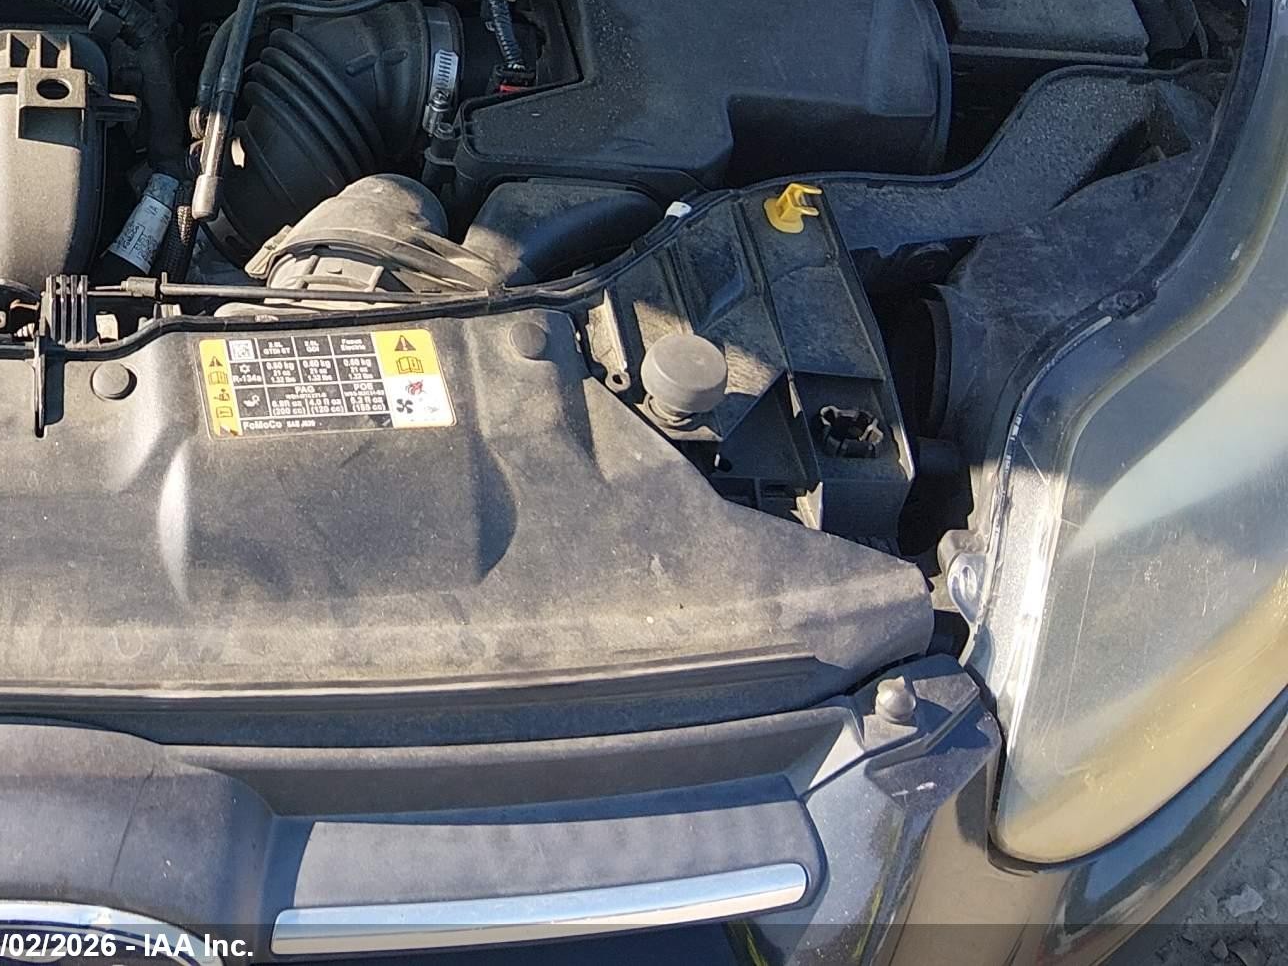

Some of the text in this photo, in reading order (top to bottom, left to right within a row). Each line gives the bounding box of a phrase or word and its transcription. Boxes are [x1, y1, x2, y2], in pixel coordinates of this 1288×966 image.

[283, 361, 295, 371] kg
[320, 359, 332, 369] kg
[360, 357, 372, 367] kg
[232, 374, 262, 383] R-134a
[294, 385, 315, 394] PAG
[292, 407, 306, 415] cc)
[311, 405, 344, 414] (120 cc)
[372, 403, 386, 411] cc)
[243, 420, 282, 430] FoMoCo
